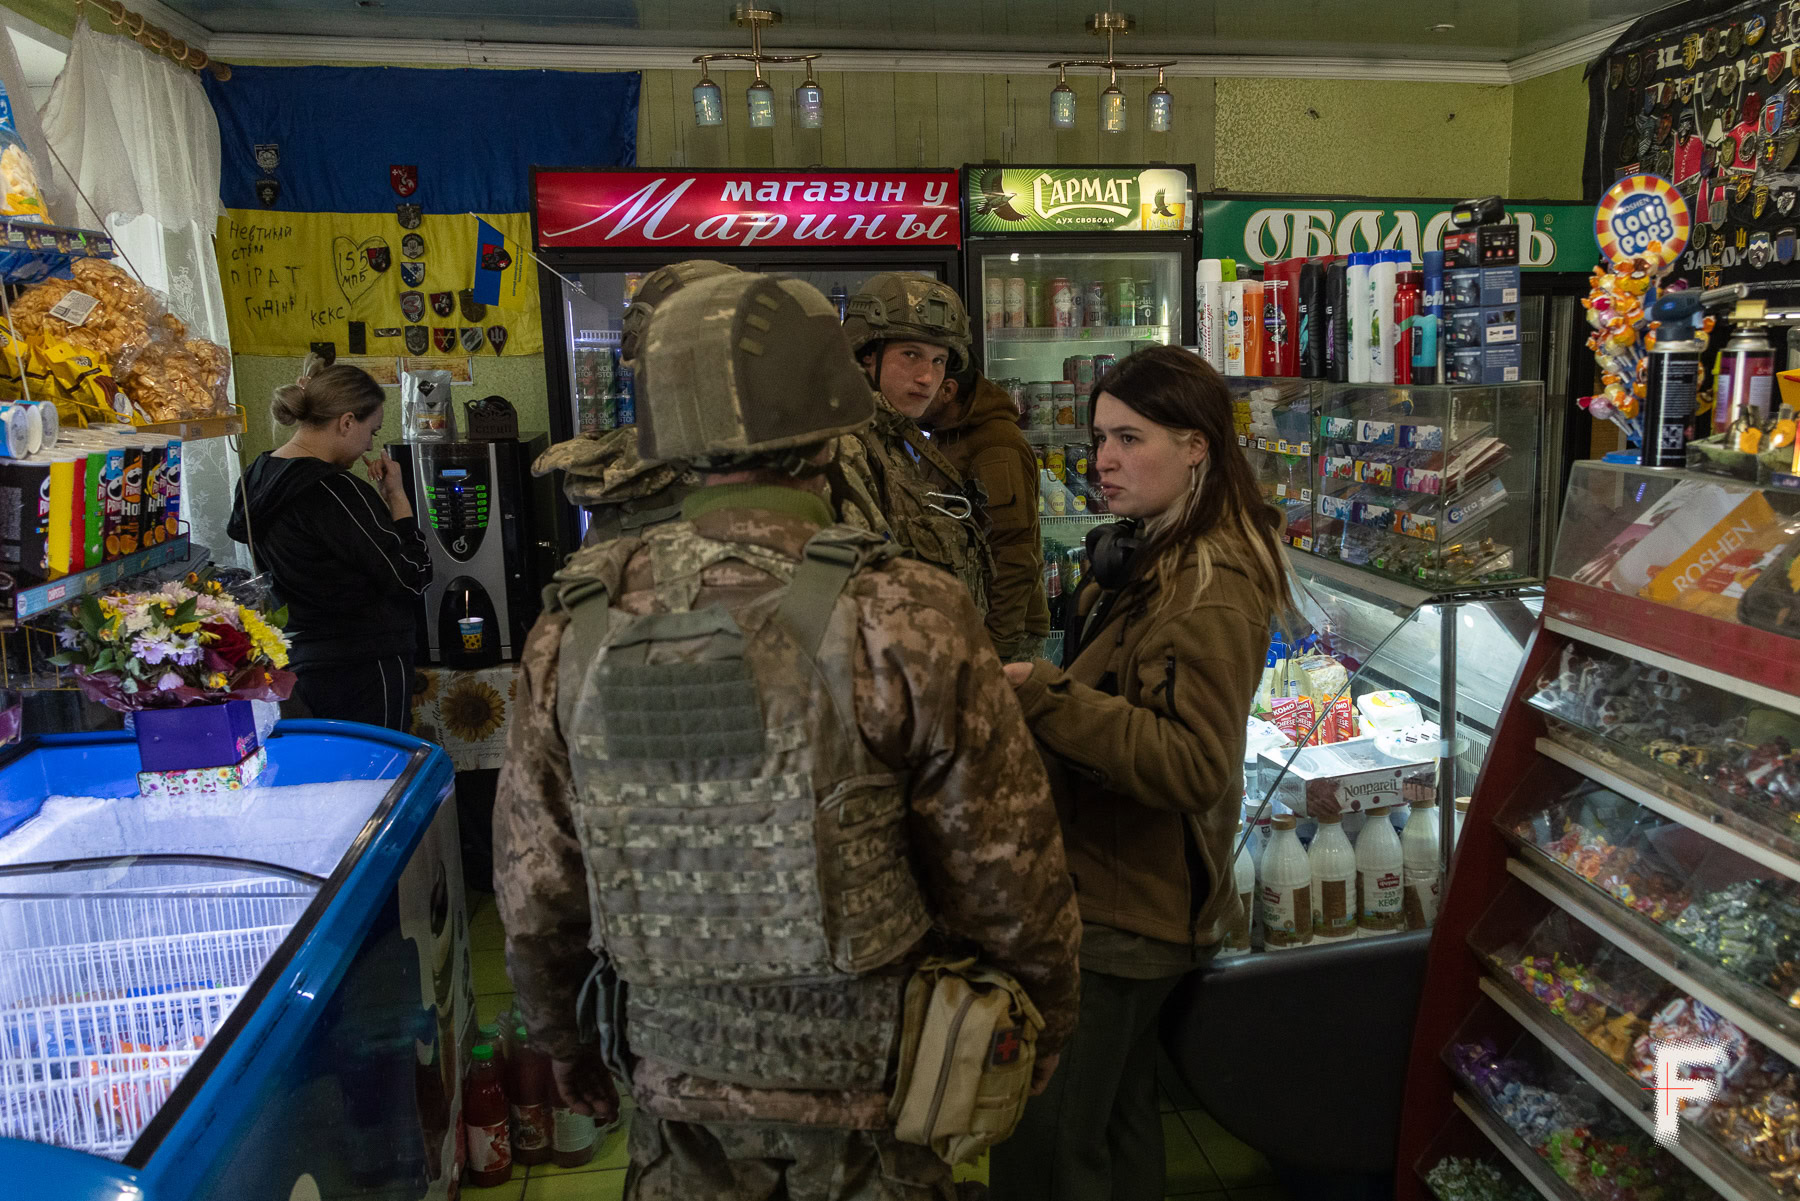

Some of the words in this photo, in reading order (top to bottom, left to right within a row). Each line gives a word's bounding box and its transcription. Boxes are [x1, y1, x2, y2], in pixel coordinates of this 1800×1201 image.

[721, 180, 905, 202] магазин
[922, 181, 948, 206] у
[1032, 173, 1133, 219] САРМАТ
[543, 178, 948, 246] Марины
[1622, 219, 1671, 253] POPS
[339, 249, 368, 276] 155
[1450, 501, 1478, 521] extra
[1672, 519, 1755, 594] ROSHEN
[1273, 703, 1295, 716] KOMO
